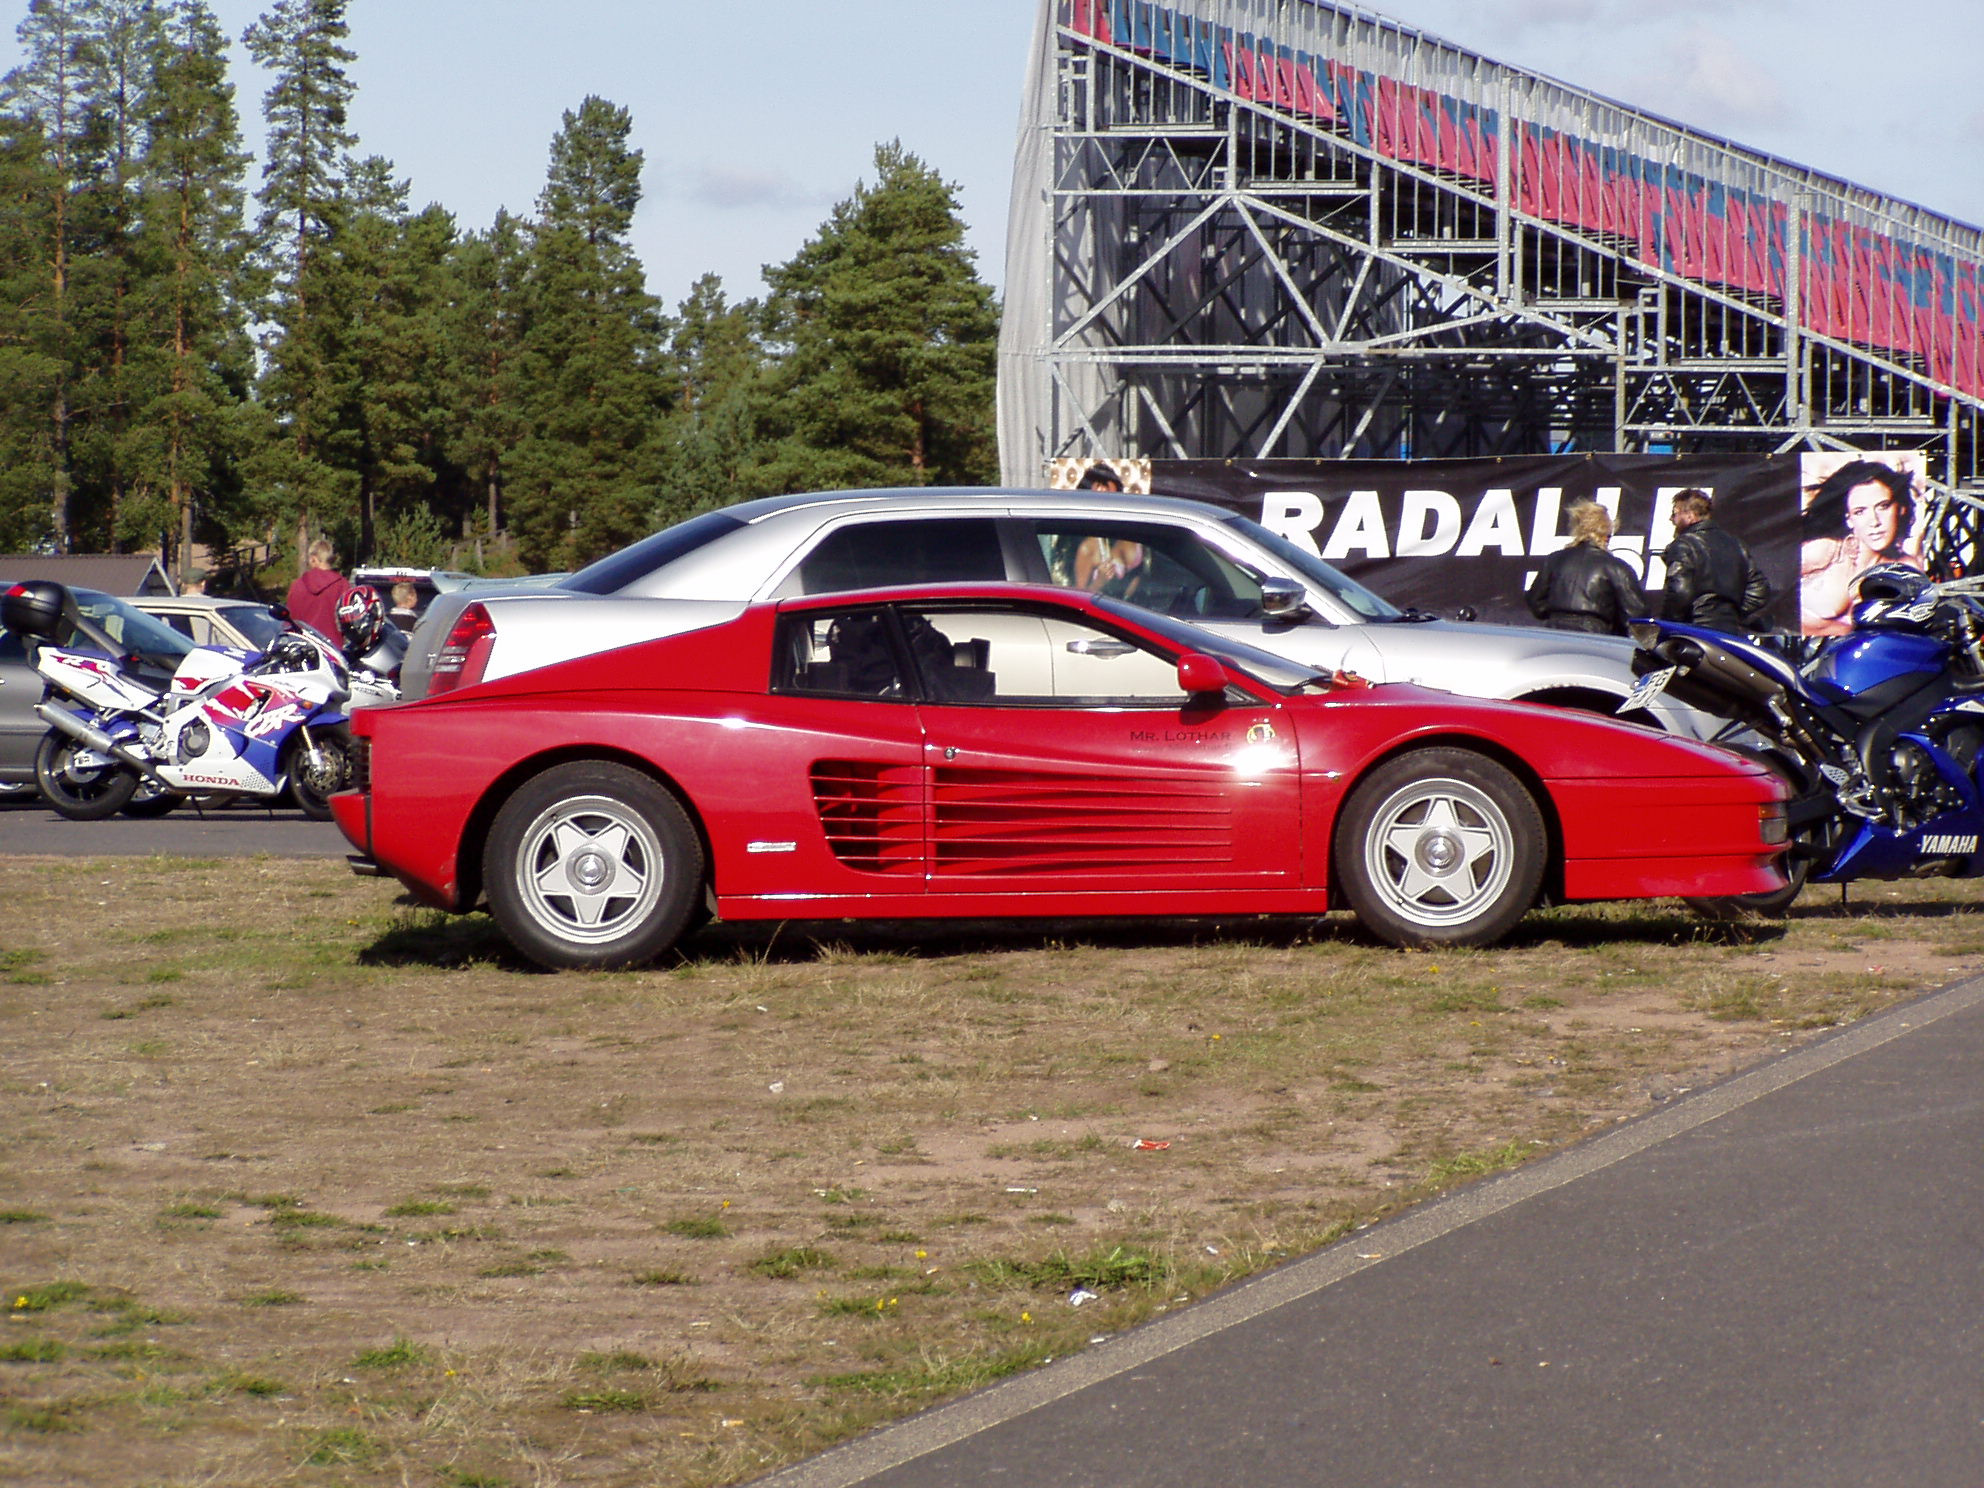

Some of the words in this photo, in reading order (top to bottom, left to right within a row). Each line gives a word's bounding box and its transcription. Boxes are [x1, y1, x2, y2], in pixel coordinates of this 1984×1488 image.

[1129, 731, 1160, 741] MR.
[1164, 730, 1231, 741] LOTHAR
[183, 774, 240, 786] HONDA
[1921, 835, 1978, 853] YAMAHA
